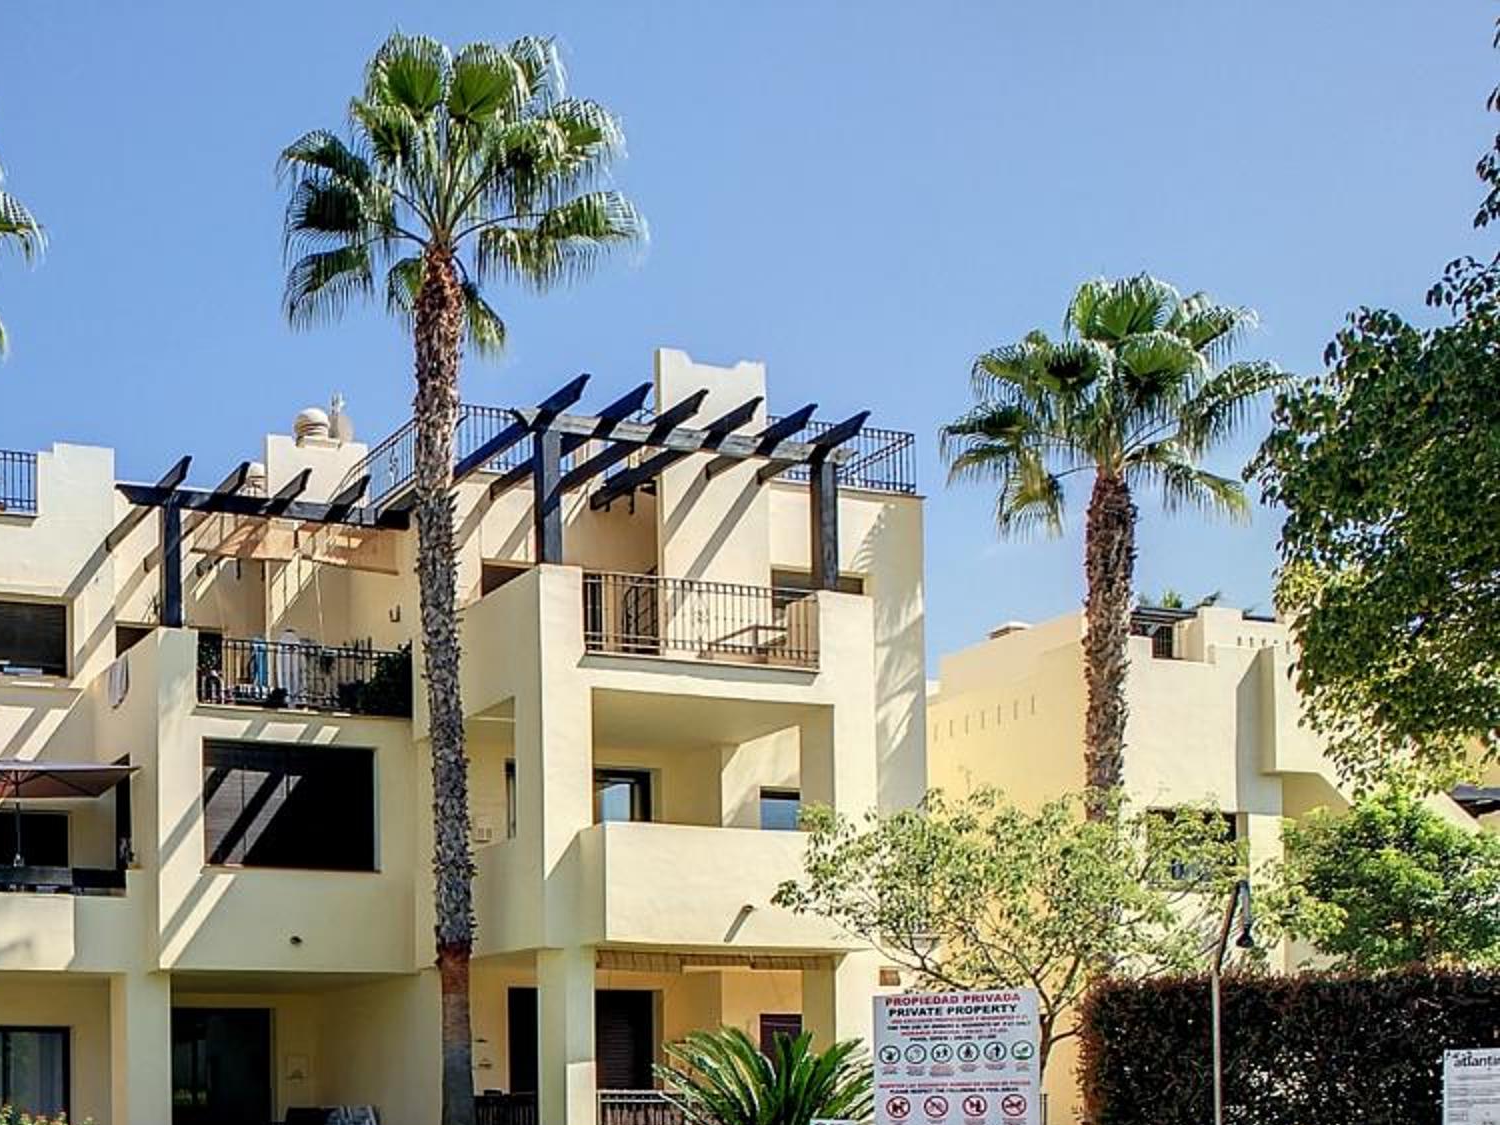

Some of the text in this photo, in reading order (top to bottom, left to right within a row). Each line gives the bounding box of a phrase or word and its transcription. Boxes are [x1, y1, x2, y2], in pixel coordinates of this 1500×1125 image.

[886, 993, 1021, 1007] PROPIEDAD PRIVADA
[889, 1004, 1018, 1017] PRIVATE PROPERTY
